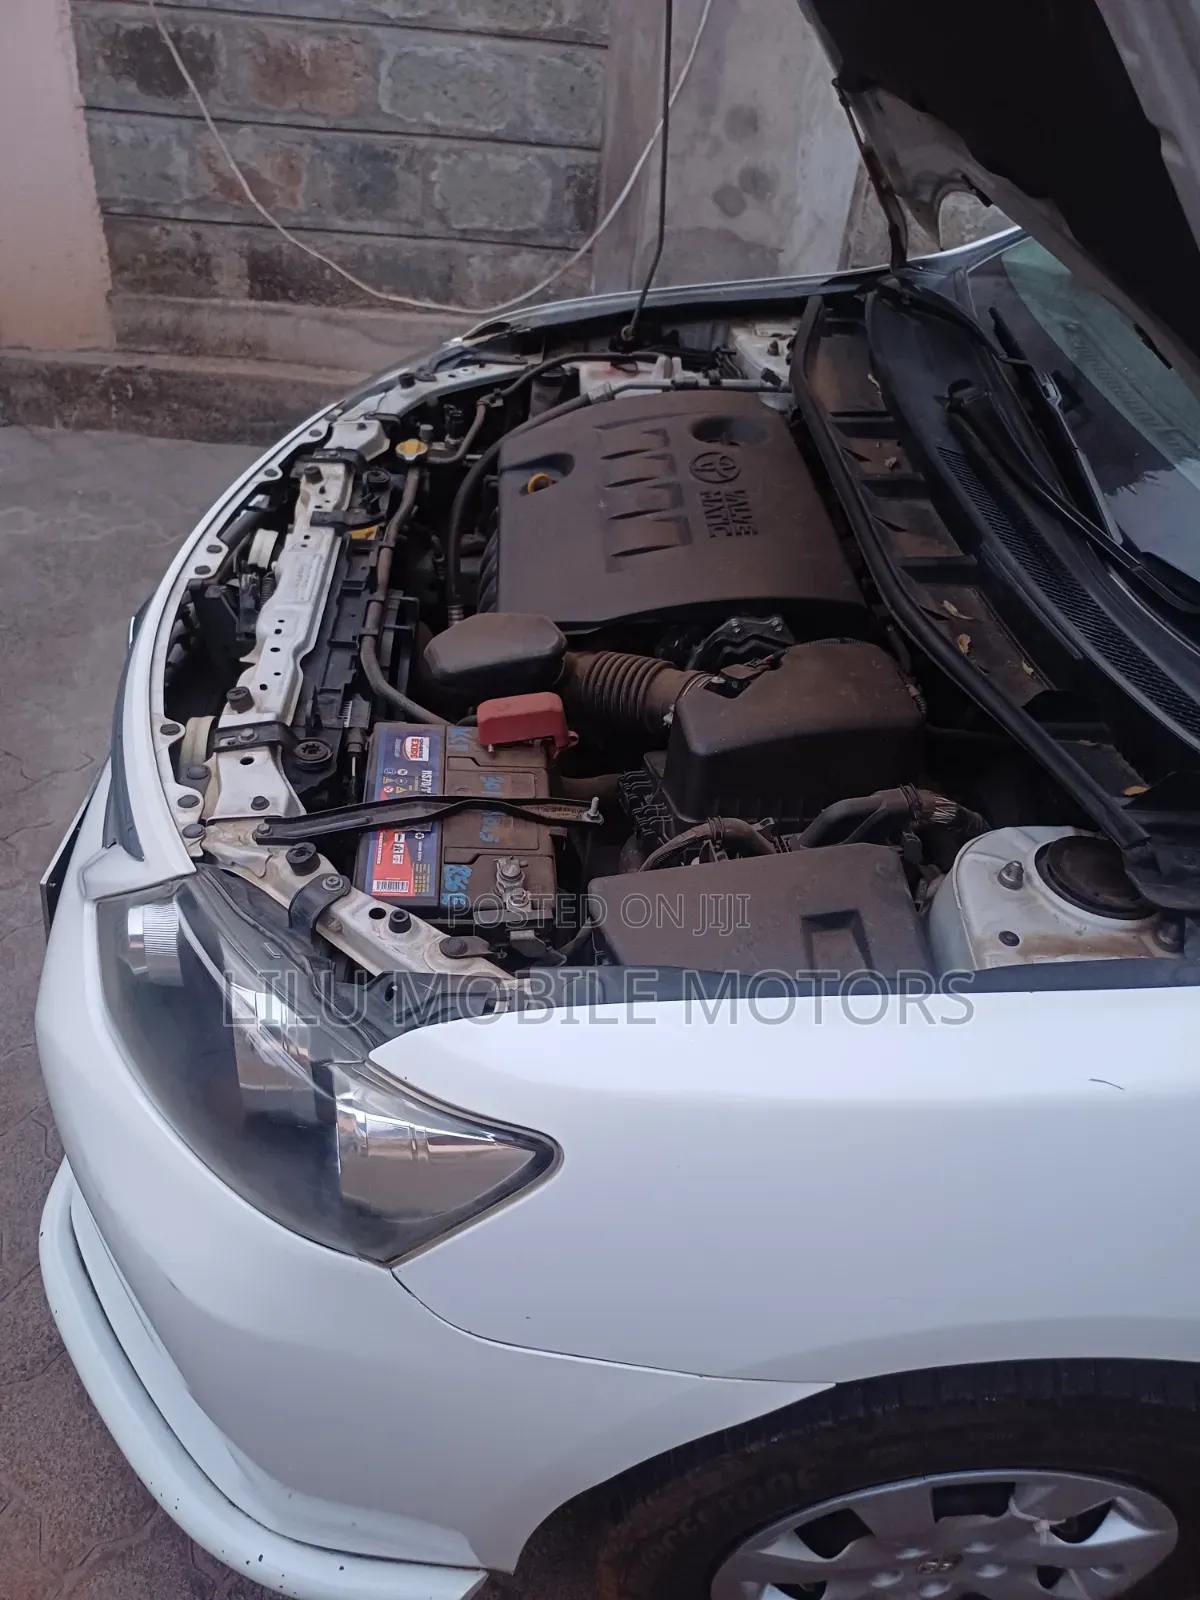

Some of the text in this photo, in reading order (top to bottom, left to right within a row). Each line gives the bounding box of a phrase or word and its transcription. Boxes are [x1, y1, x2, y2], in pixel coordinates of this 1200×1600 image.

[699, 490, 733, 538] MATIC
[726, 489, 758, 536] VALVE
[410, 738, 419, 759] EXIDE
